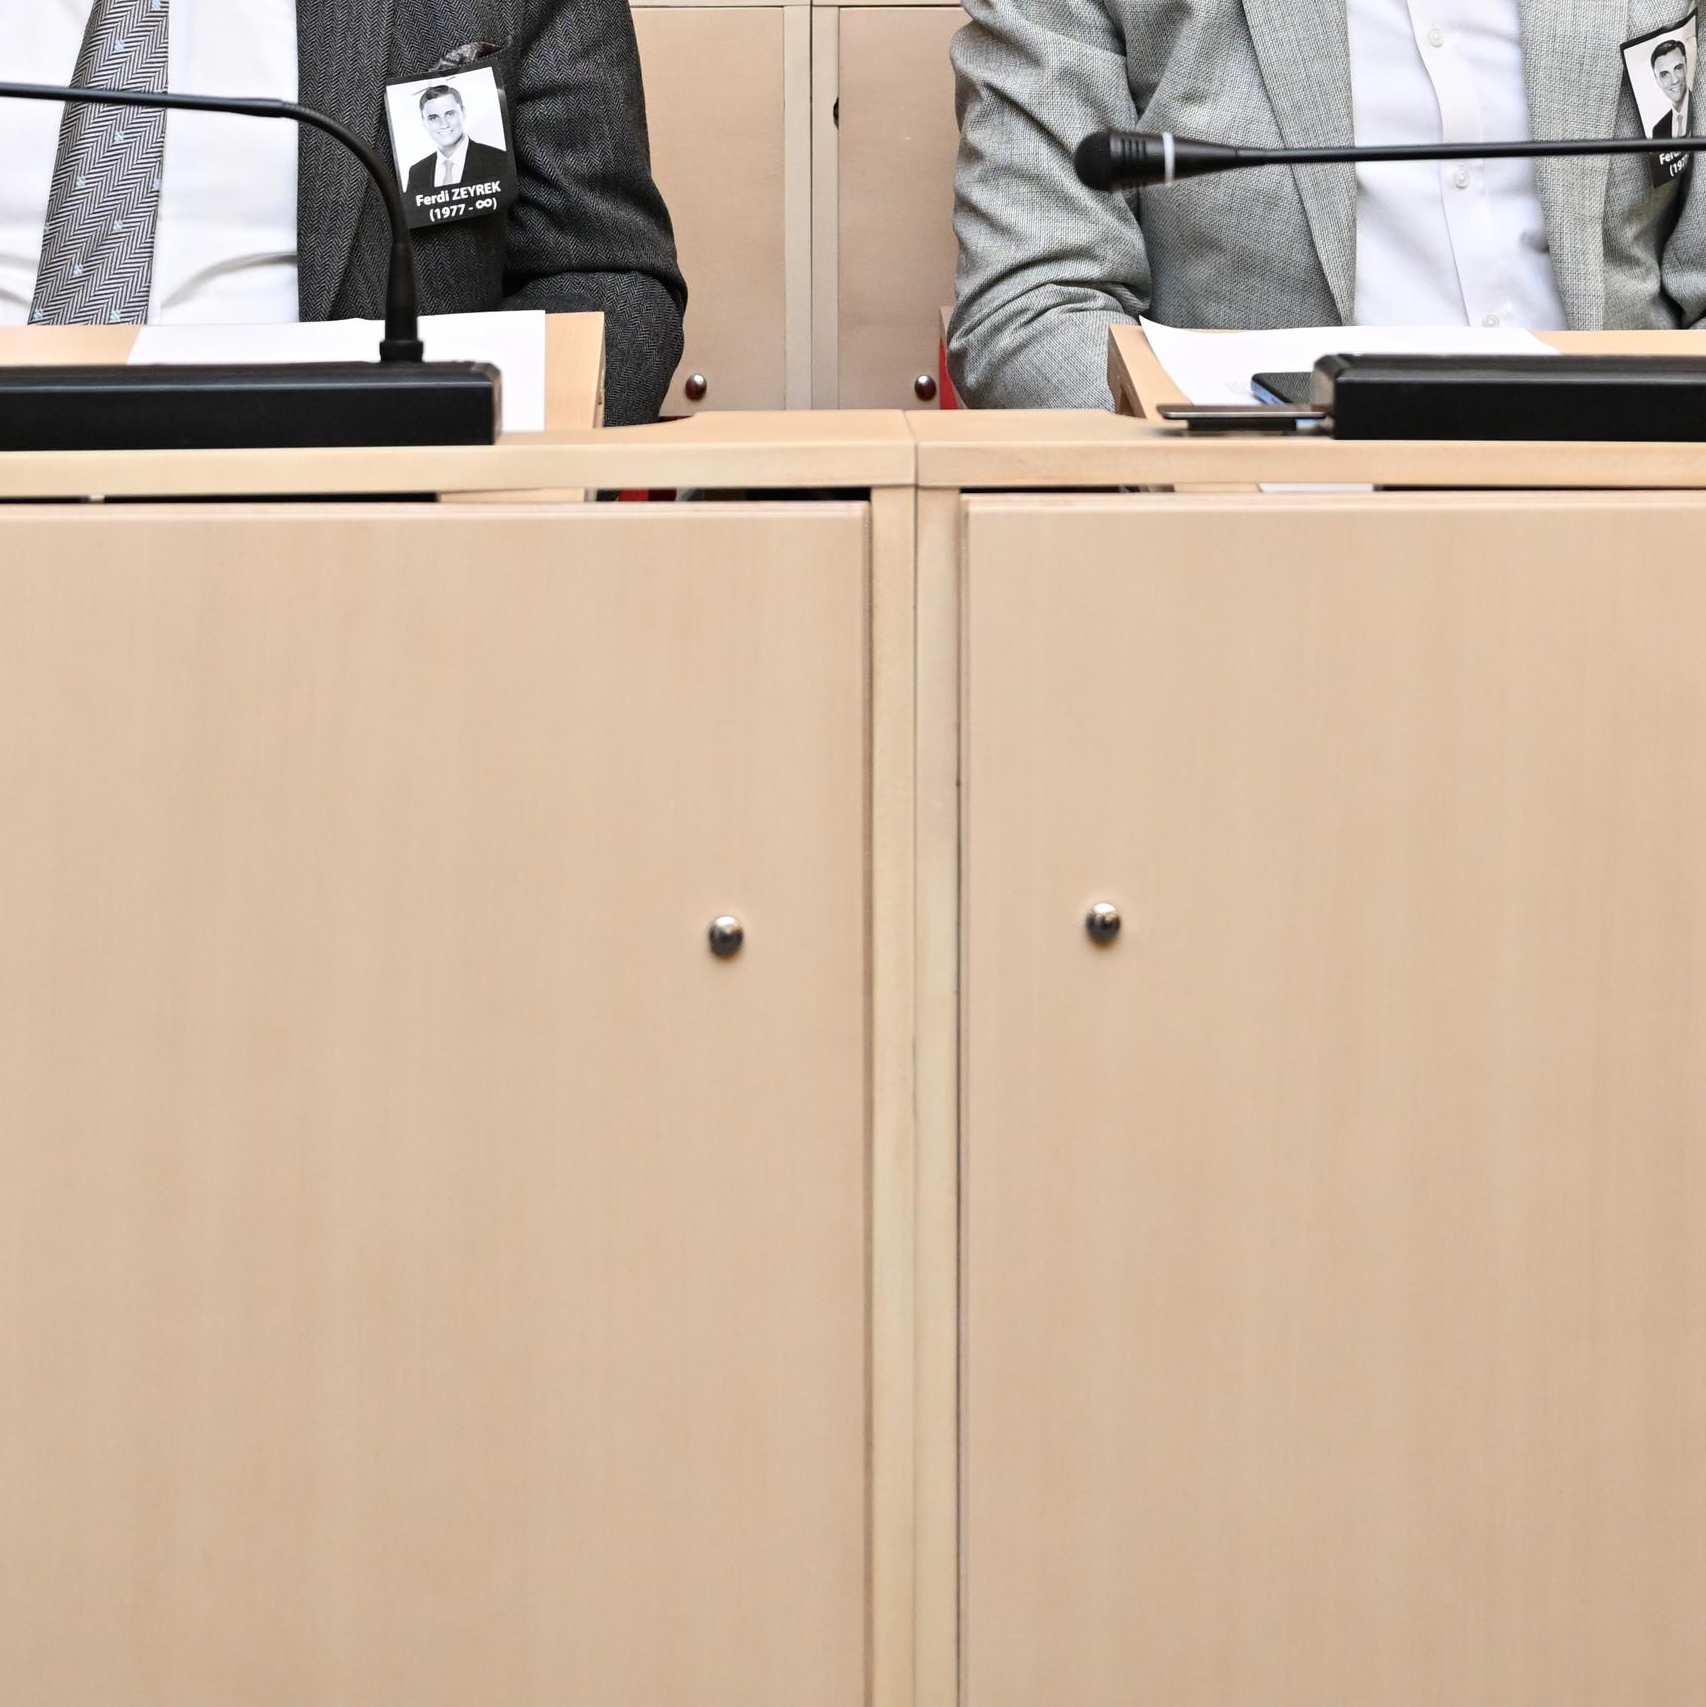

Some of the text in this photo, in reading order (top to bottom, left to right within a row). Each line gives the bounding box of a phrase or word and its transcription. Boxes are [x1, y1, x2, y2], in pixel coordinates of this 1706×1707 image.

[415, 180, 502, 207] Ferdi ZEYREK
[429, 203, 466, 222] (1977
